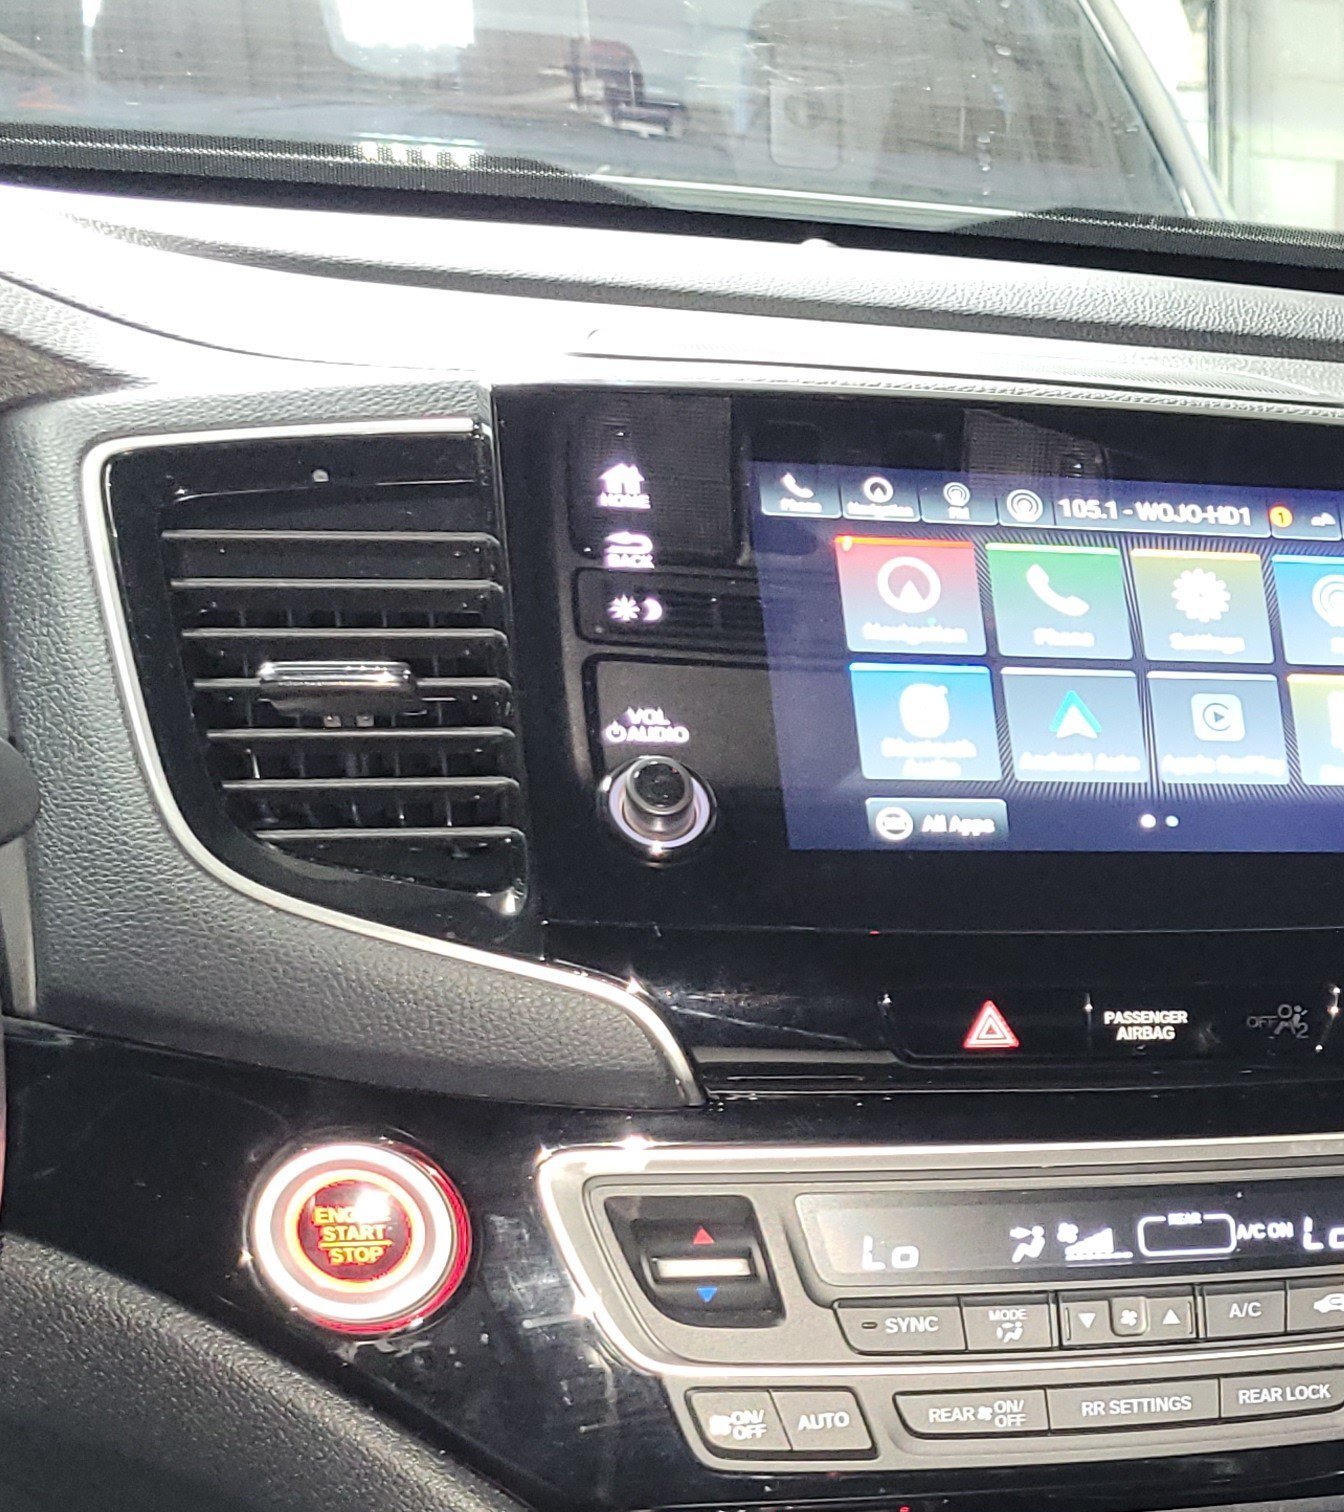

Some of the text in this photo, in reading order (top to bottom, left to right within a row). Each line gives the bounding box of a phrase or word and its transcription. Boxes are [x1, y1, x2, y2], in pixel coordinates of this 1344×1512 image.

[1058, 498, 1118, 521] 105.1
[627, 706, 671, 726] VOL
[626, 726, 690, 743] AUDIO
[1103, 1010, 1188, 1025] PASSENGER
[1116, 1025, 1176, 1041] AIRBAG
[322, 1225, 386, 1243] START
[1237, 1222, 1294, 1240] A/C ON
[329, 1247, 384, 1265] STOP
[989, 1309, 1027, 1322] MODE
[1229, 1302, 1262, 1320] A/C
[885, 1316, 939, 1335] SYNC
[1238, 1383, 1331, 1404] REAR LOCK
[929, 1405, 975, 1424] REAR
[1081, 1395, 1192, 1416] RR SETTINGS
[799, 1411, 849, 1432] AUTO
[994, 1412, 1027, 1427] OFF
[733, 1423, 767, 1441] OFF
